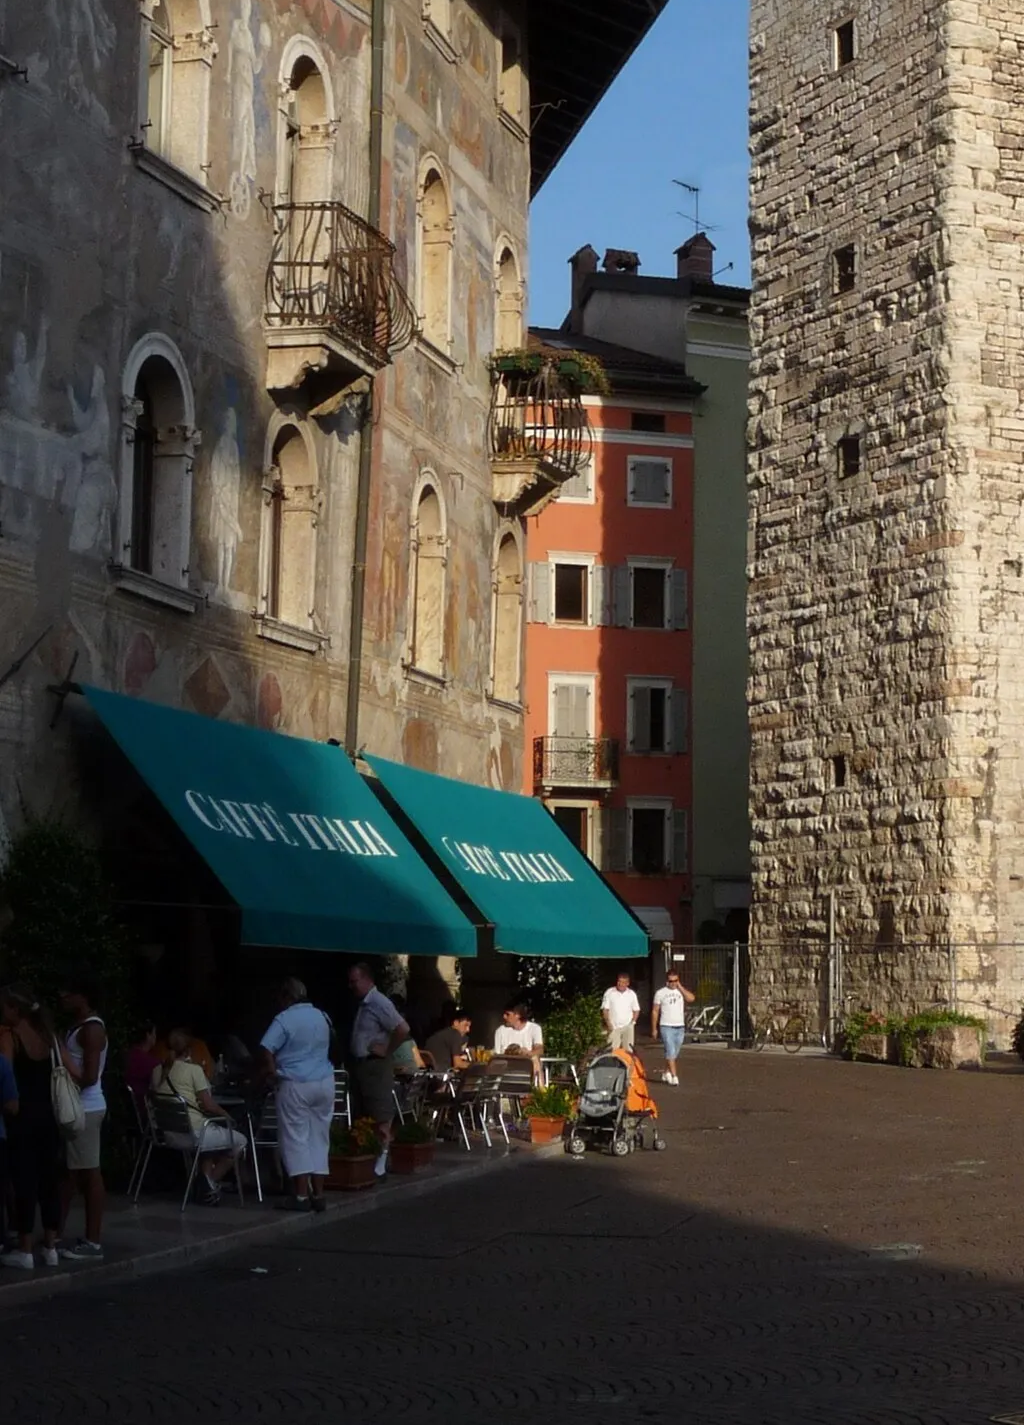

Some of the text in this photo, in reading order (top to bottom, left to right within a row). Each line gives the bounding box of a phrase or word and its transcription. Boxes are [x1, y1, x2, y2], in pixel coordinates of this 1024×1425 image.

[185, 789, 398, 857] CAFFÈ ITALIA
[498, 851, 574, 883] ITALIA
